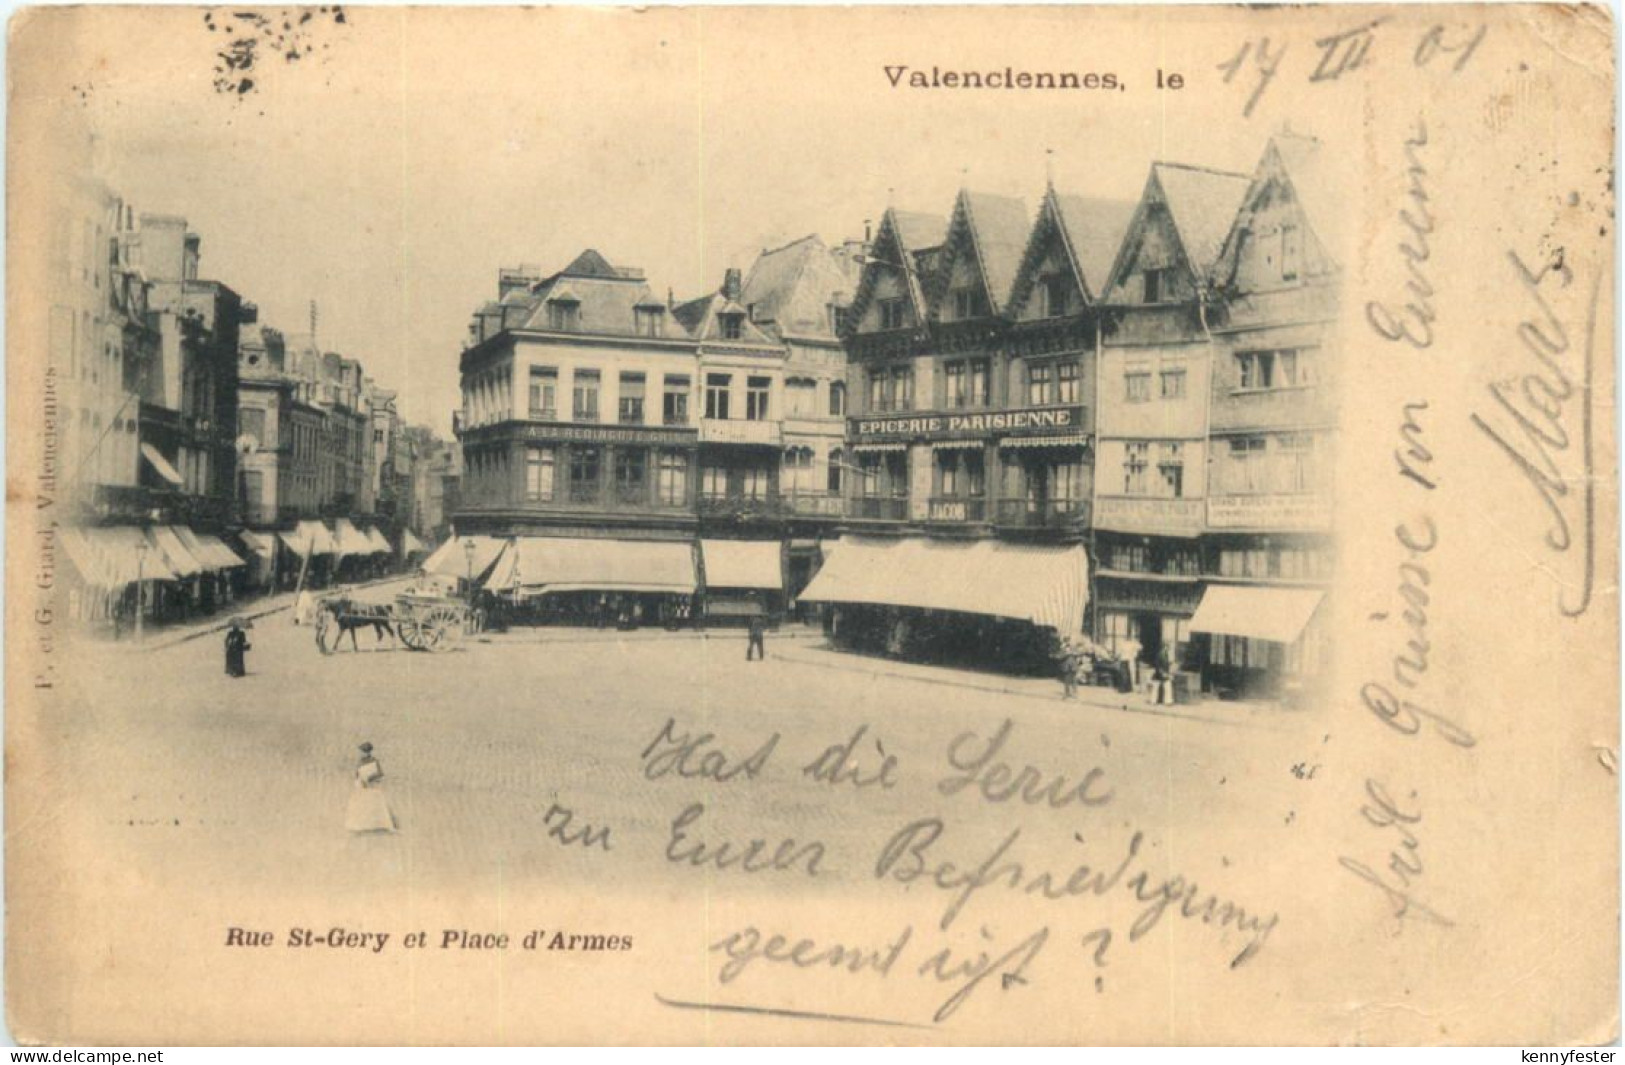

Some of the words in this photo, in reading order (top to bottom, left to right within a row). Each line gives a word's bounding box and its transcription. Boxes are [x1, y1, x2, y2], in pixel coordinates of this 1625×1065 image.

[859, 417, 942, 434] EPICERIE
[949, 410, 1071, 430] PARISIENNE
[803, 724, 900, 791] die
